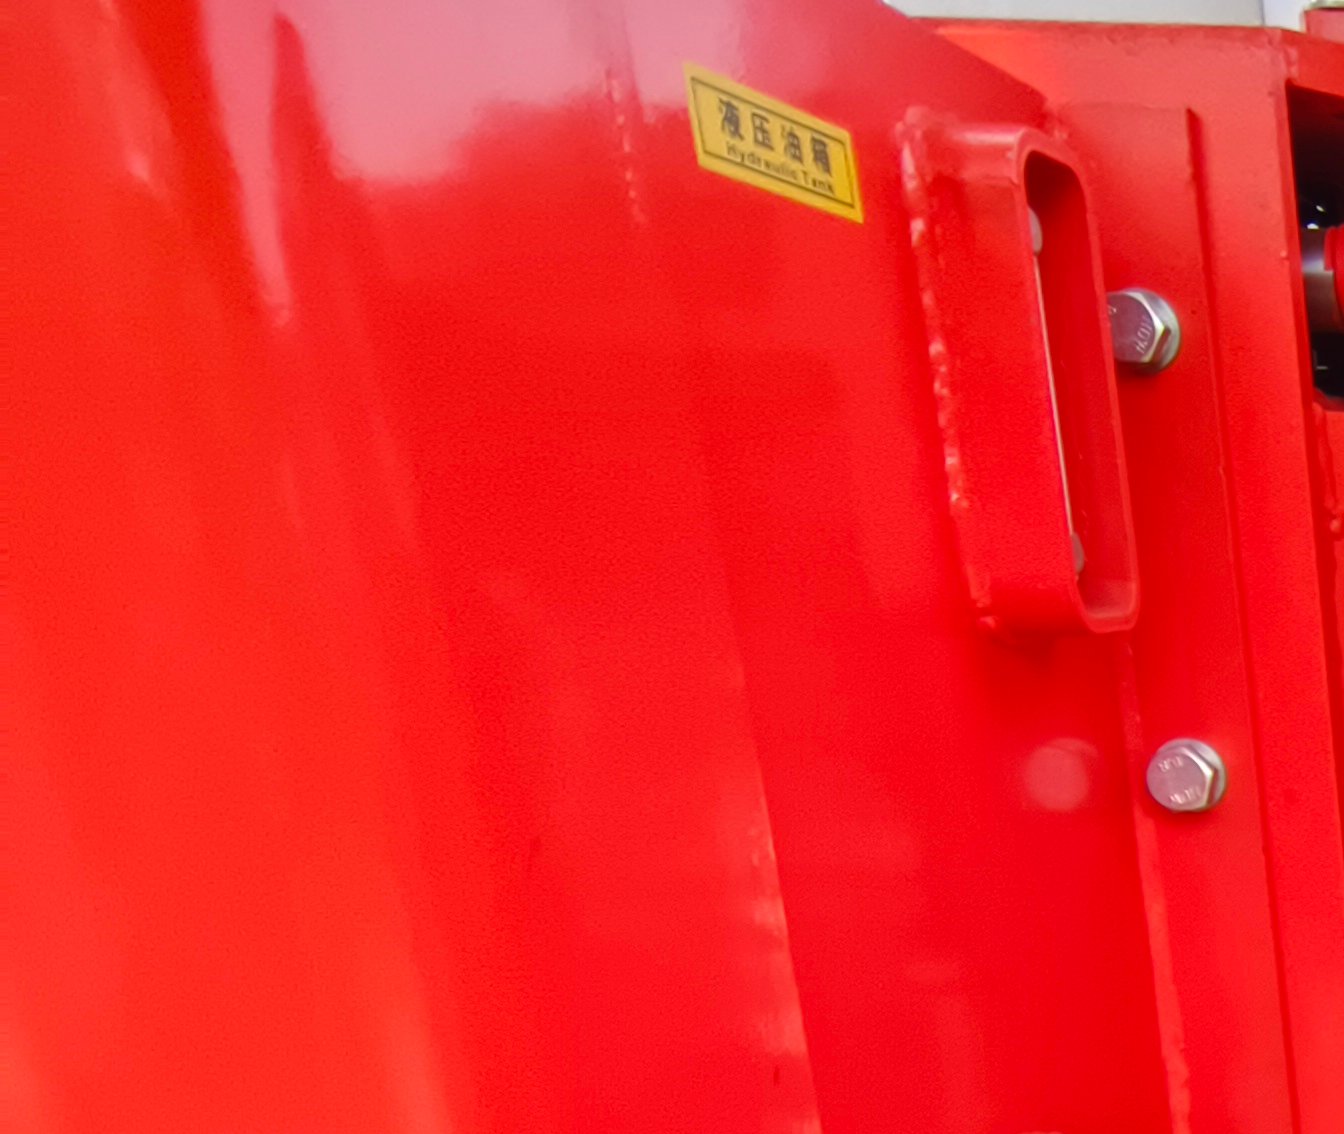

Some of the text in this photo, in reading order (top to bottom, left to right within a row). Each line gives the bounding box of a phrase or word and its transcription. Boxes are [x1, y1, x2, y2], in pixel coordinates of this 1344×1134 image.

[718, 97, 833, 178] 液压油箱
[726, 143, 834, 195] Hydraulic Tank
